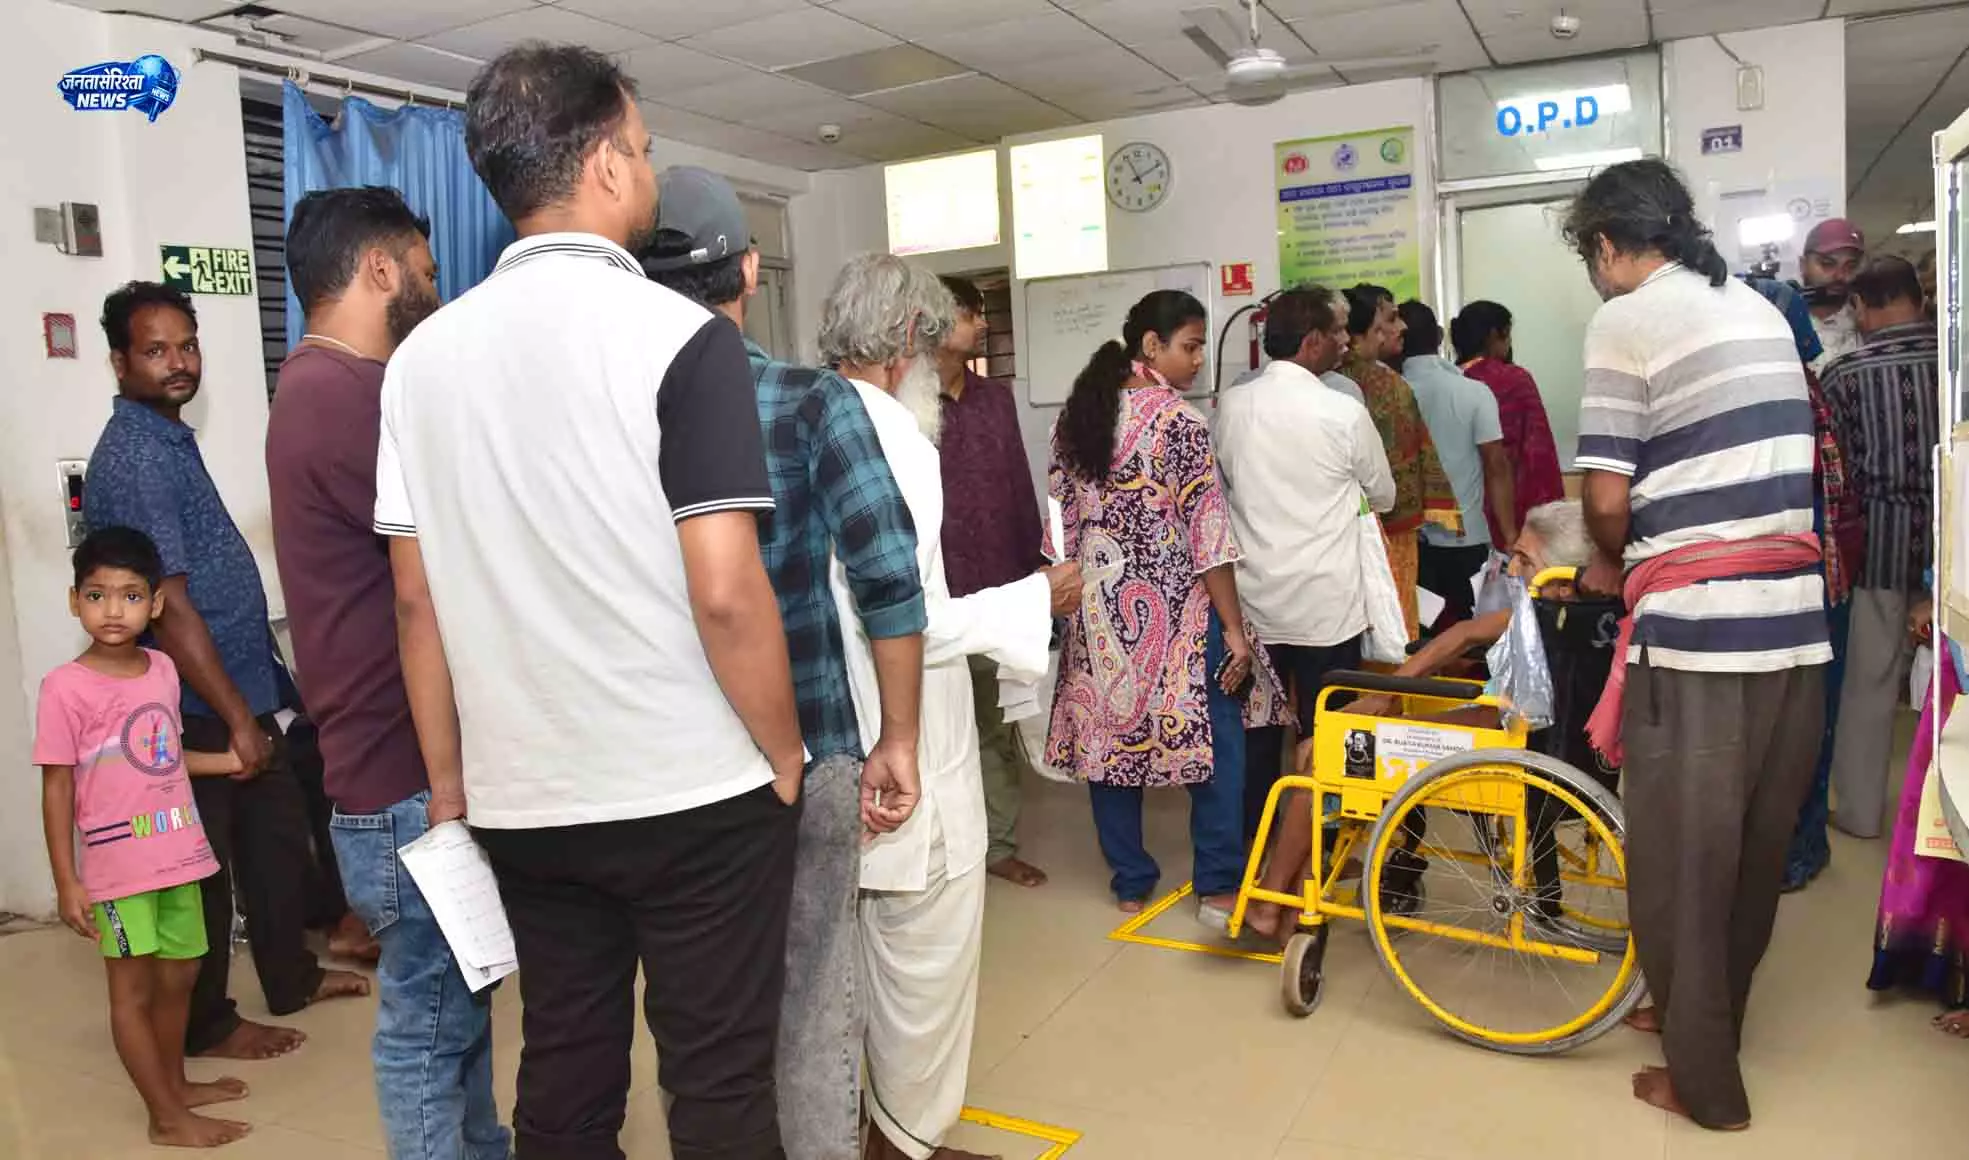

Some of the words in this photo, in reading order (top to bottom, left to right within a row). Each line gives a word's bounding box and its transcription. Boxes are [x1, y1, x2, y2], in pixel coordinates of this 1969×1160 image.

[1497, 95, 1599, 137] O.P.D
[1711, 136, 1733, 152] 01
[212, 249, 249, 272] FIRE
[214, 271, 251, 293] EXIT
